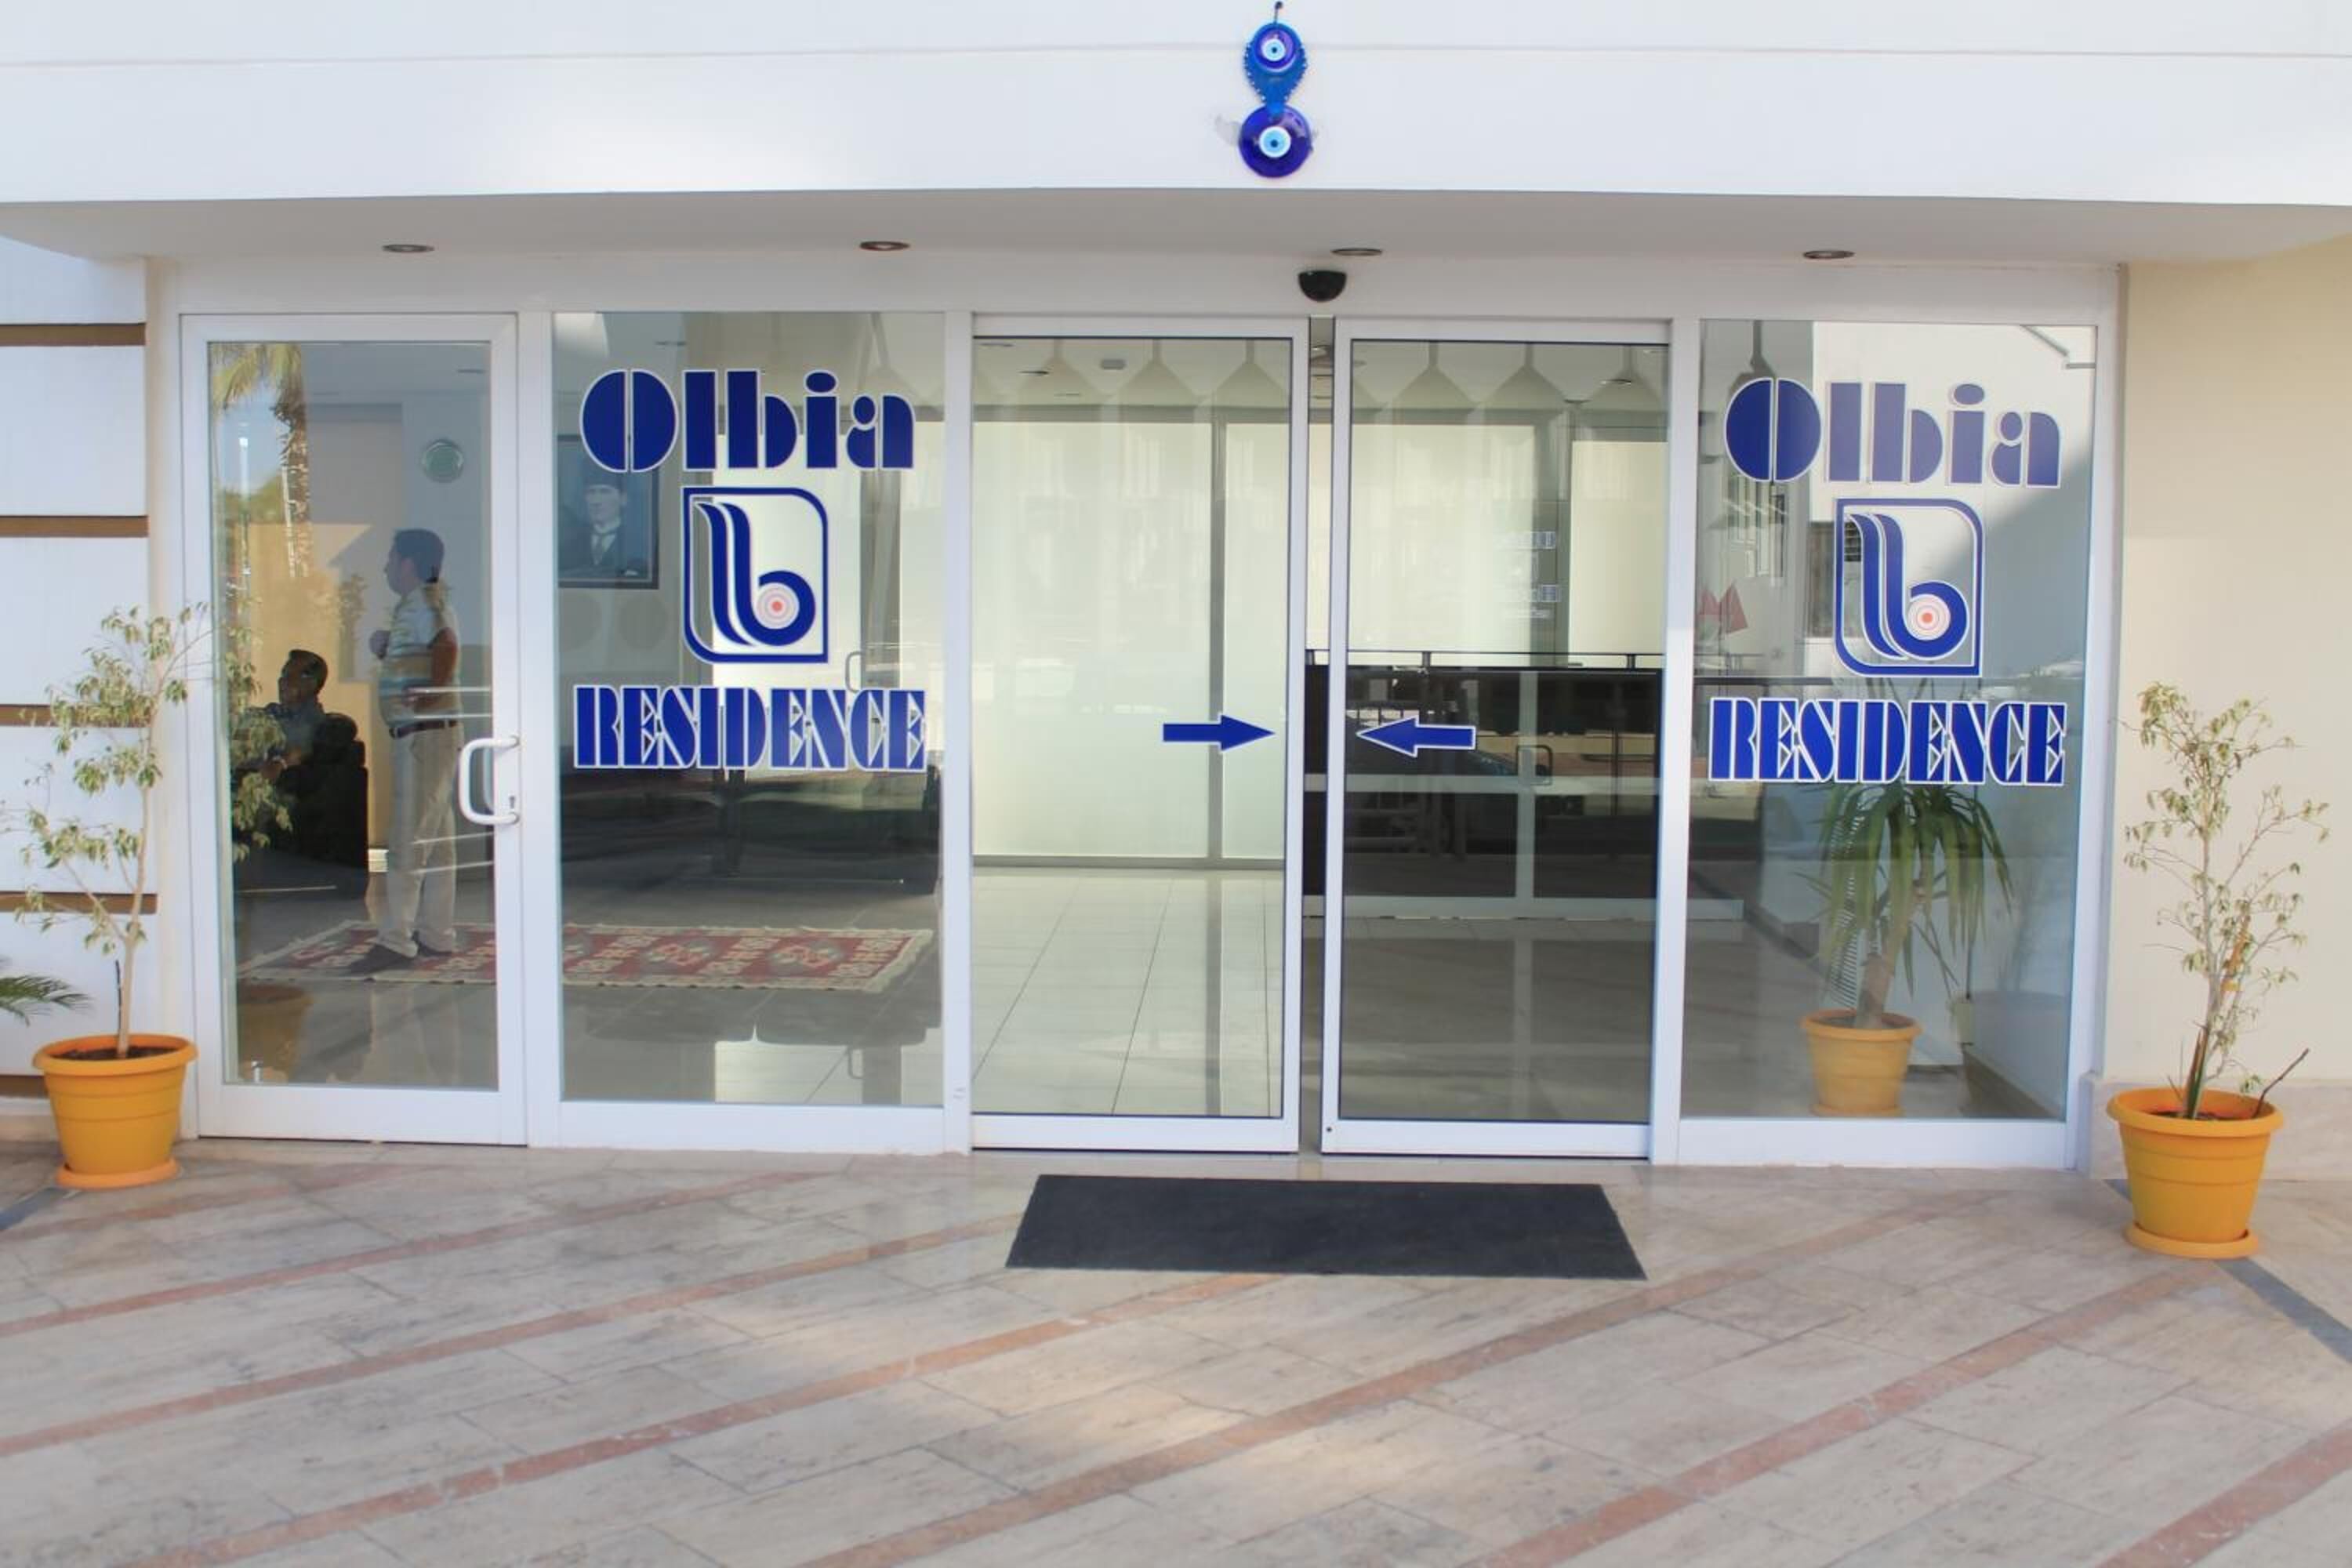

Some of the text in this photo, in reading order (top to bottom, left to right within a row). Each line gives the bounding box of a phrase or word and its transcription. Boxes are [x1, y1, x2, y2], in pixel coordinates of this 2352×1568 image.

[581, 369, 914, 471] Olbia
[1725, 377, 2061, 488] Olbia
[574, 685, 926, 771] RESIDENCE
[1709, 697, 2067, 786] RESIDENCE
